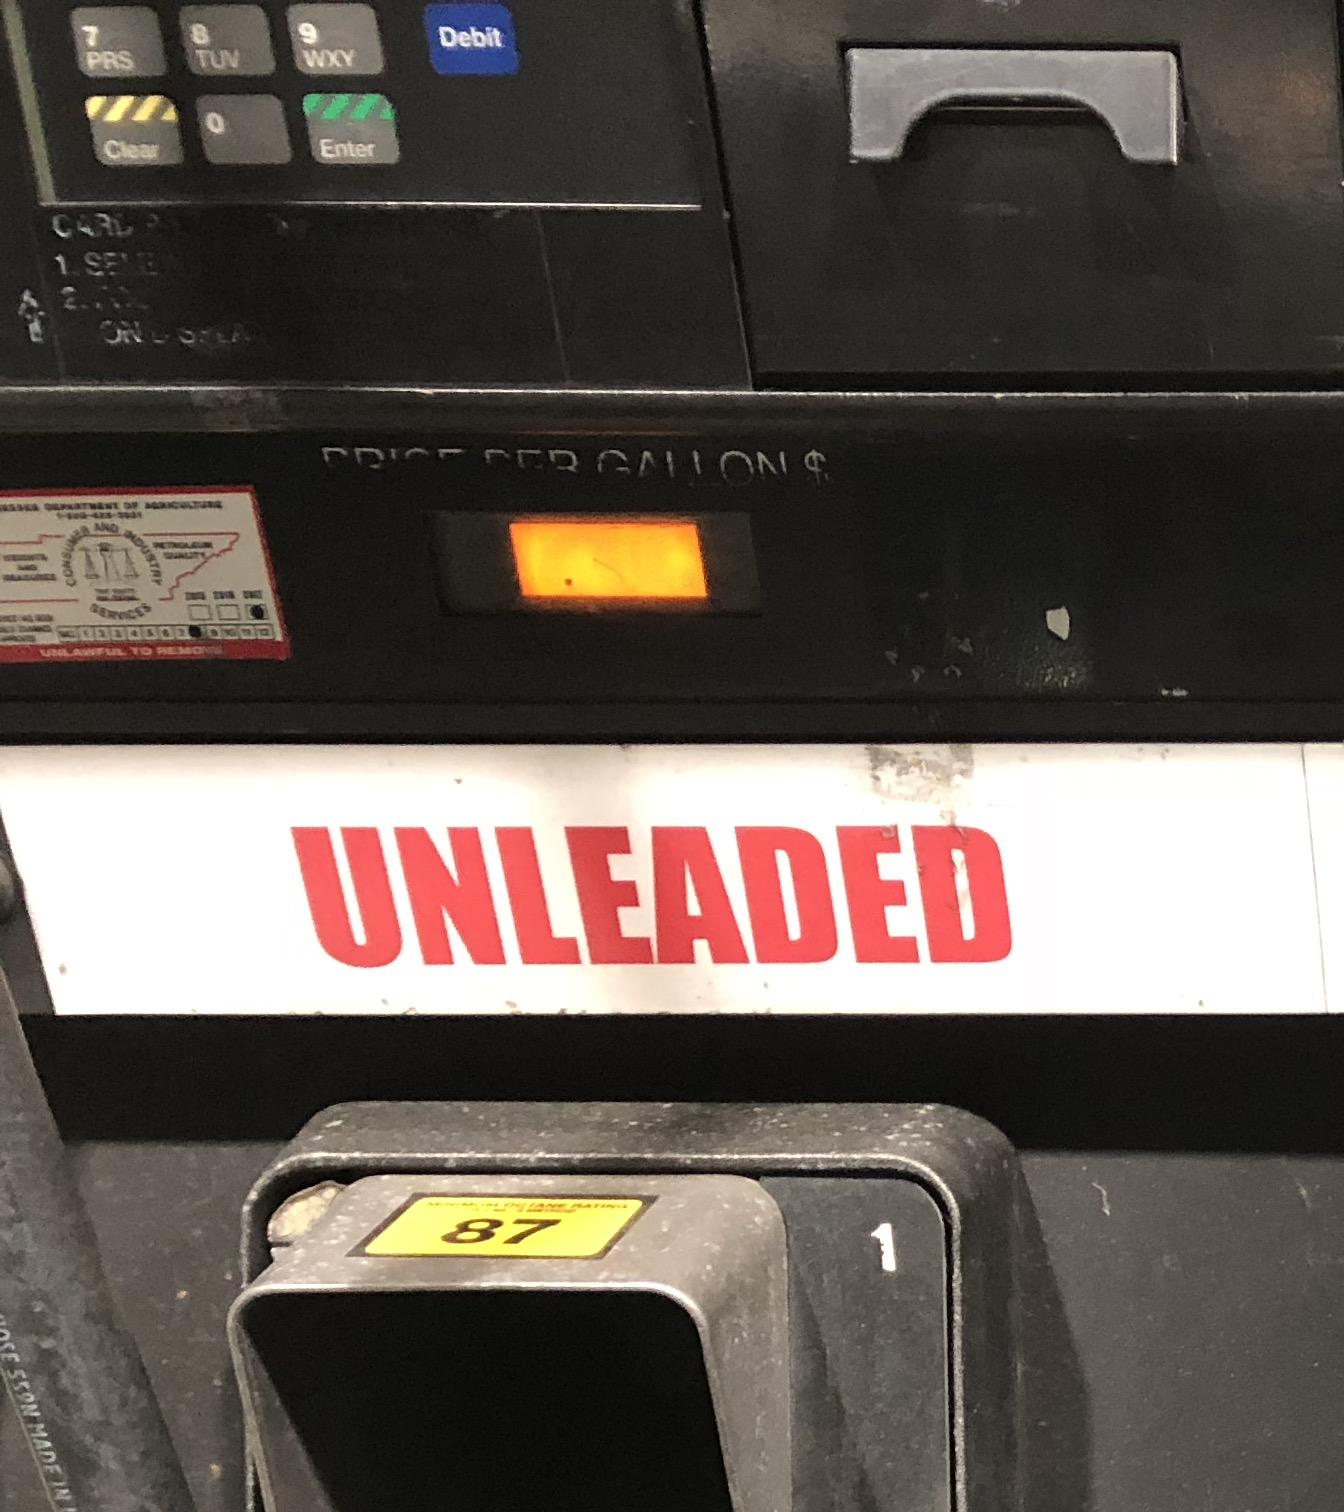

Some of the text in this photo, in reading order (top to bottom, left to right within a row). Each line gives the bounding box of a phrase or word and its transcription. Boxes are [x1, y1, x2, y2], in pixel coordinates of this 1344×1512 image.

[82, 25, 100, 45] 7
[191, 23, 210, 45] 8
[300, 23, 318, 44] 9
[438, 26, 503, 48] Debit
[87, 49, 134, 70] PRS
[196, 49, 241, 70] TUV
[302, 49, 356, 69] WXY
[206, 113, 225, 134] 0
[104, 140, 160, 161] Clear
[320, 139, 376, 160] Enter
[291, 825, 1012, 969] UNLEADED
[441, 1218, 562, 1244] 87
[871, 1222, 896, 1272] 1
